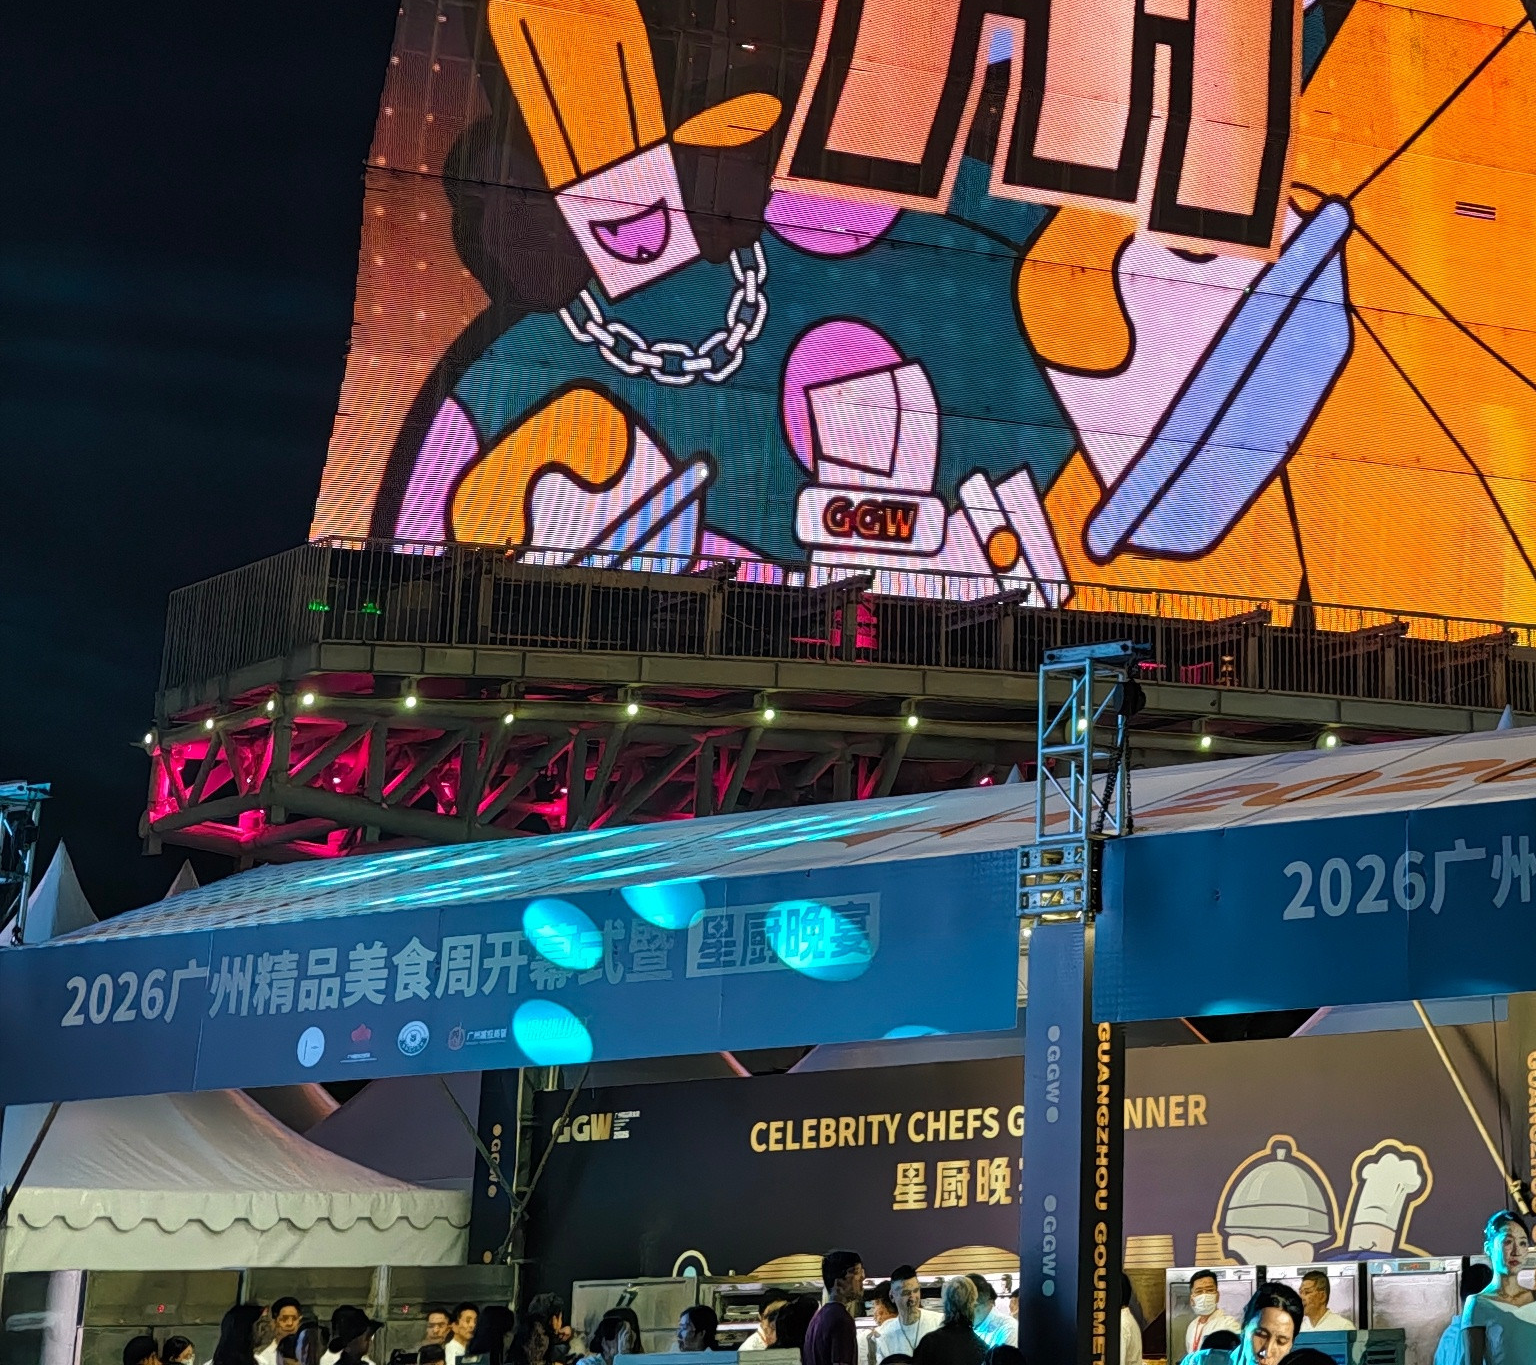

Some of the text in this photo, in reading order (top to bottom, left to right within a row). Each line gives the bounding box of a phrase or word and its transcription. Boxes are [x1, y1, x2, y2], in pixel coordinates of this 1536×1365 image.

[823, 500, 920, 541] GGW
[1046, 1045, 1061, 1103] GGW
[750, 1113, 902, 1153] CELEBRITY
[908, 1106, 1000, 1142] CHEFS
[1124, 1094, 1208, 1130] NNER
[1094, 1021, 1112, 1211] GUANGZHOU
[892, 1158, 1024, 1211] 星厨晚
[1042, 1215, 1058, 1276] GGW
